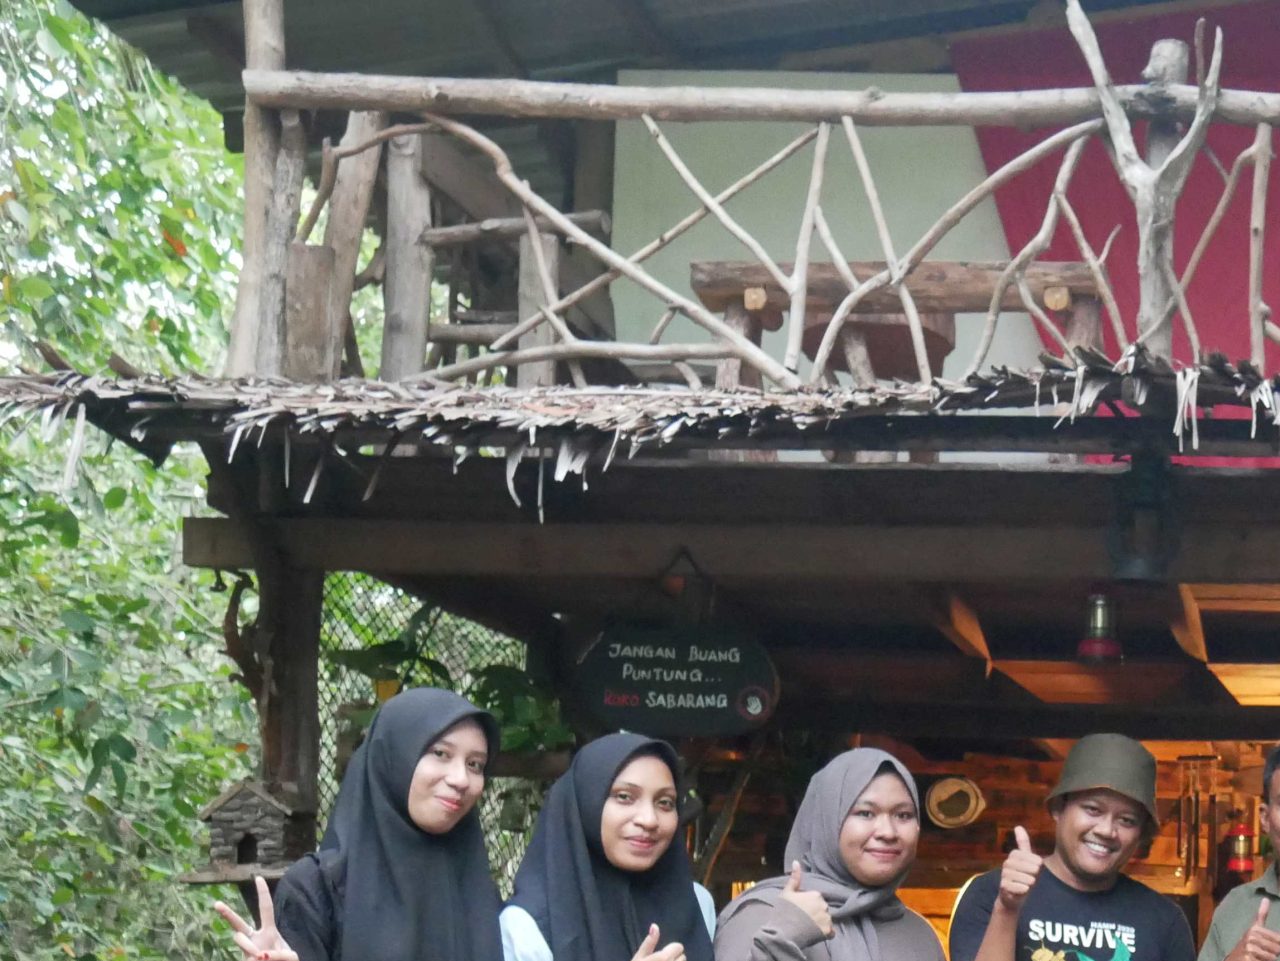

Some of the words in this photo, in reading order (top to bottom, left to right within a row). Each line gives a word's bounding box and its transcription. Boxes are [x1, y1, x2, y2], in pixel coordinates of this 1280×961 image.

[608, 643, 676, 659] JANGAN
[688, 645, 741, 663] BUANG
[645, 691, 728, 709] SABARANG
[1028, 919, 1136, 953] SURVIVE
